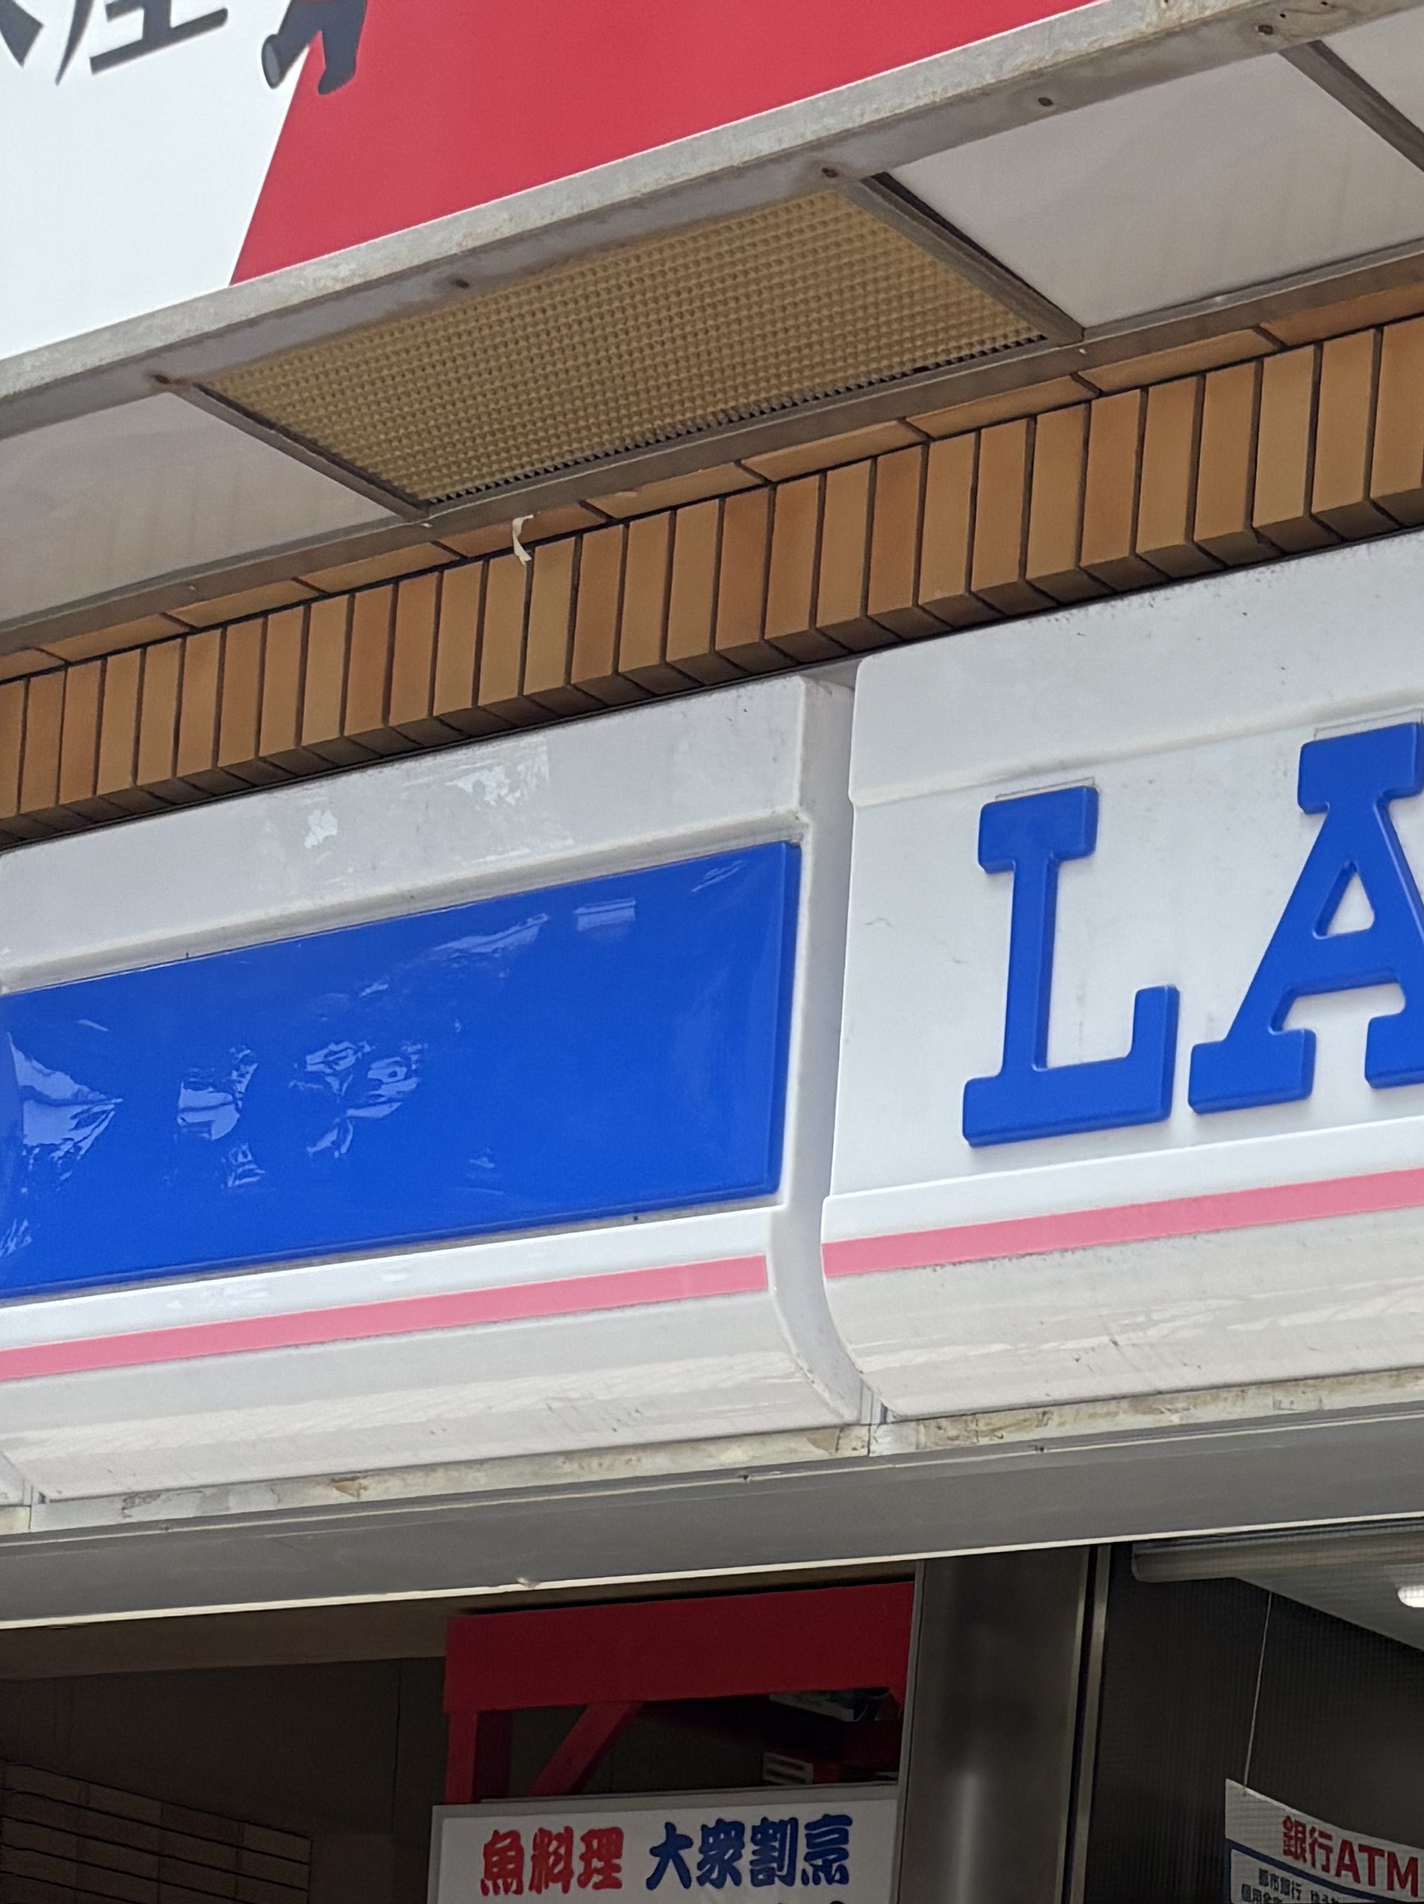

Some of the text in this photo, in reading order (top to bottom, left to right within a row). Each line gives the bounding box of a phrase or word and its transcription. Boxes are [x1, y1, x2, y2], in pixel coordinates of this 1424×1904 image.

[480, 1814, 853, 1896] 魚料理 大衆割烹
[1282, 1816, 1419, 1897] 銀行ATM
